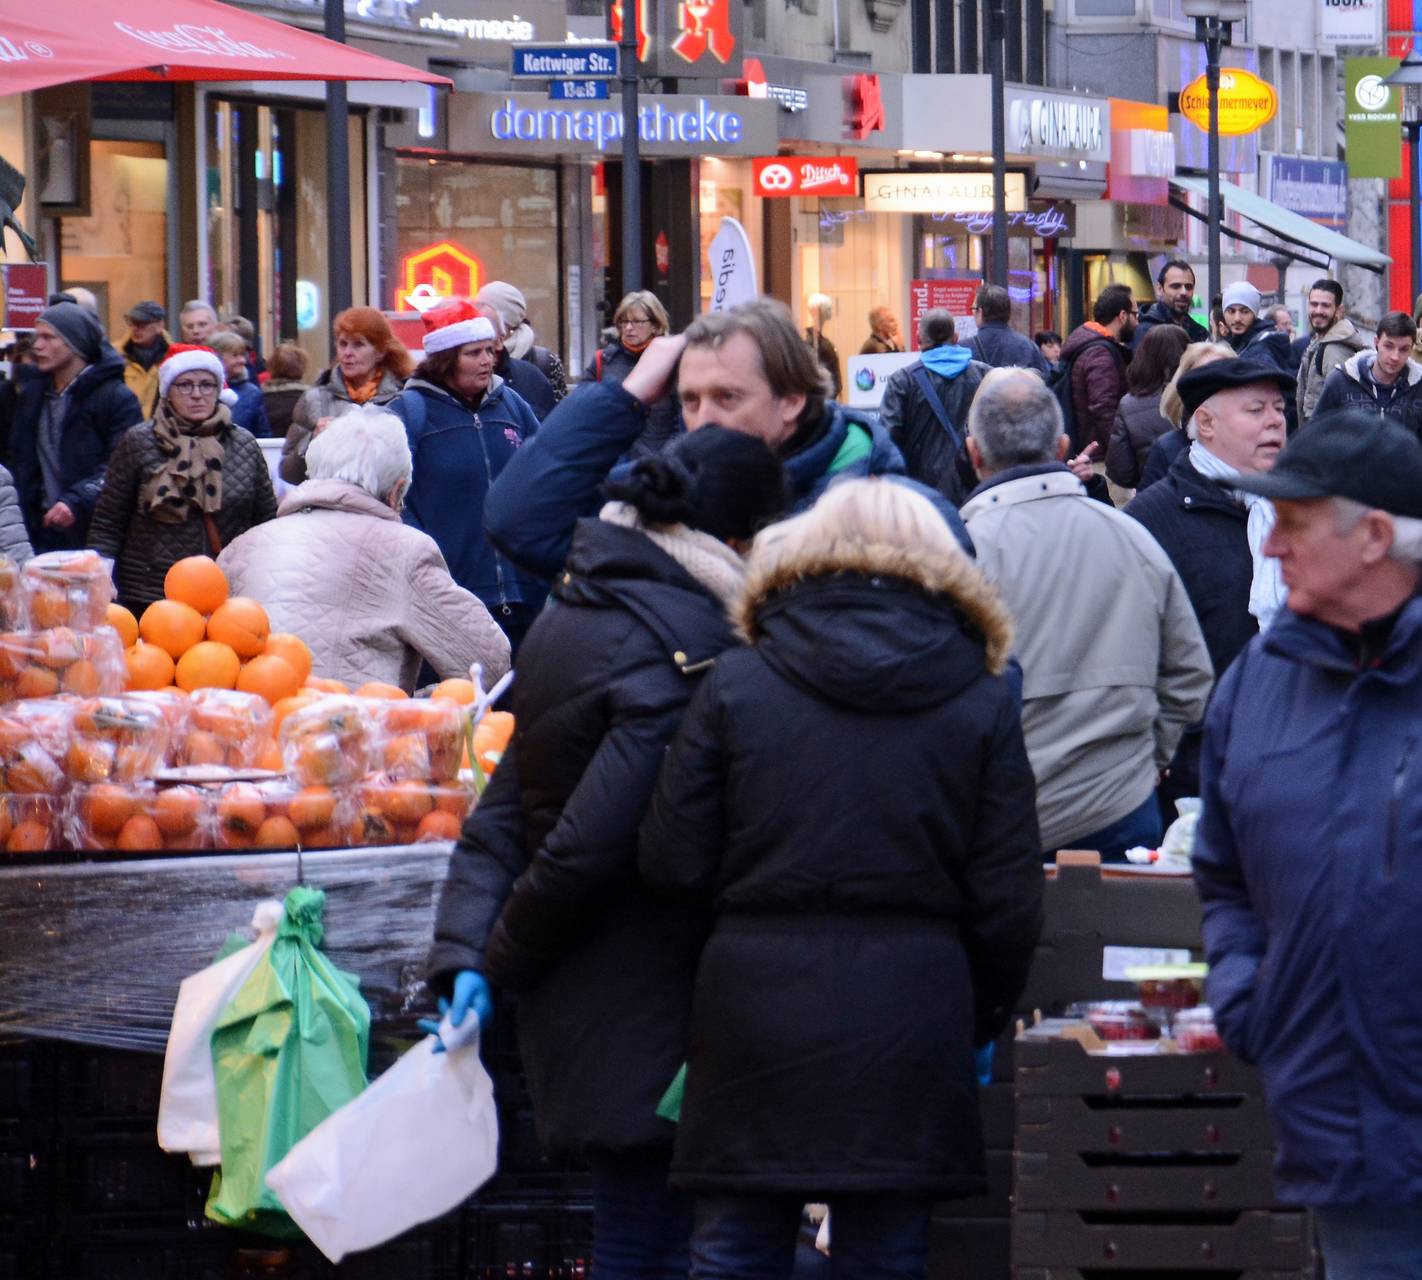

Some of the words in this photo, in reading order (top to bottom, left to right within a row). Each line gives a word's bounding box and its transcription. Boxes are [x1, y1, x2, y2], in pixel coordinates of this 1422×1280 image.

[523, 53, 586, 74] Kettwiger
[588, 53, 614, 72] Str.
[1185, 95, 1269, 111] Schlemermeyer
[491, 98, 741, 150] domaptheke
[800, 162, 842, 184] Ditsch
